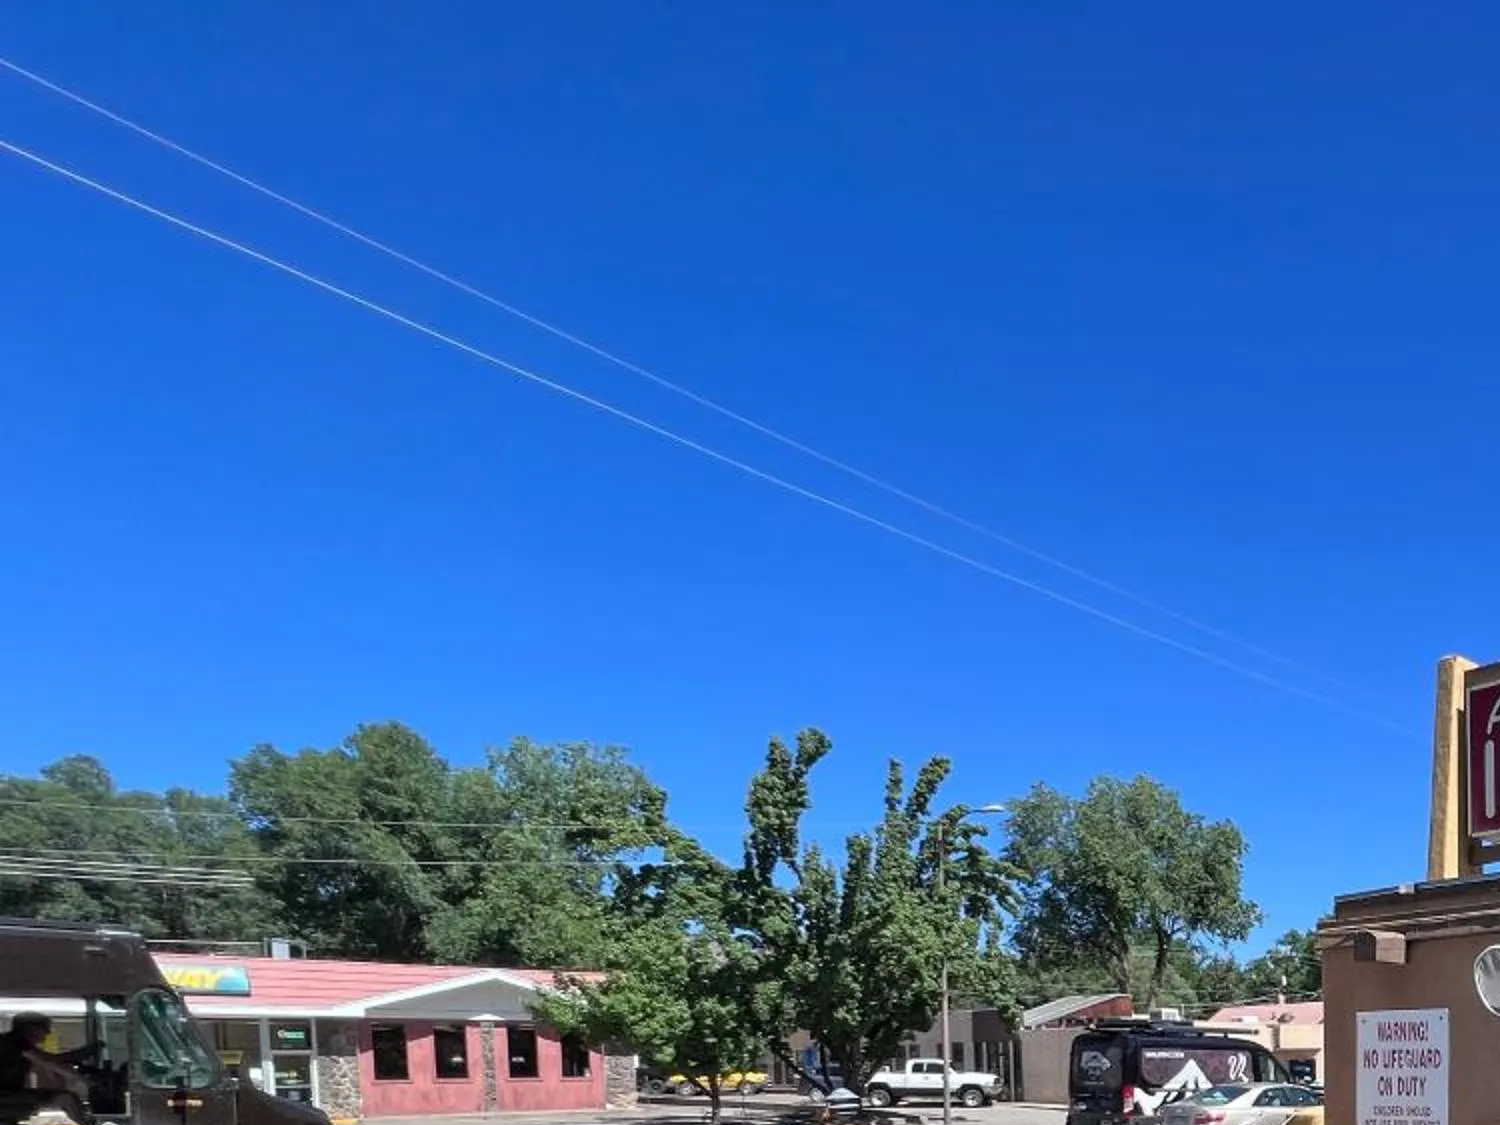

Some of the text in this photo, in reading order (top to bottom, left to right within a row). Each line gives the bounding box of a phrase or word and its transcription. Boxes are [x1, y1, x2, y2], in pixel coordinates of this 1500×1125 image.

[1377, 1021, 1429, 1042] WARNING!
[1363, 1048, 1441, 1069] NO LIFEGUARD
[1377, 1075, 1427, 1097] ON DUTY
